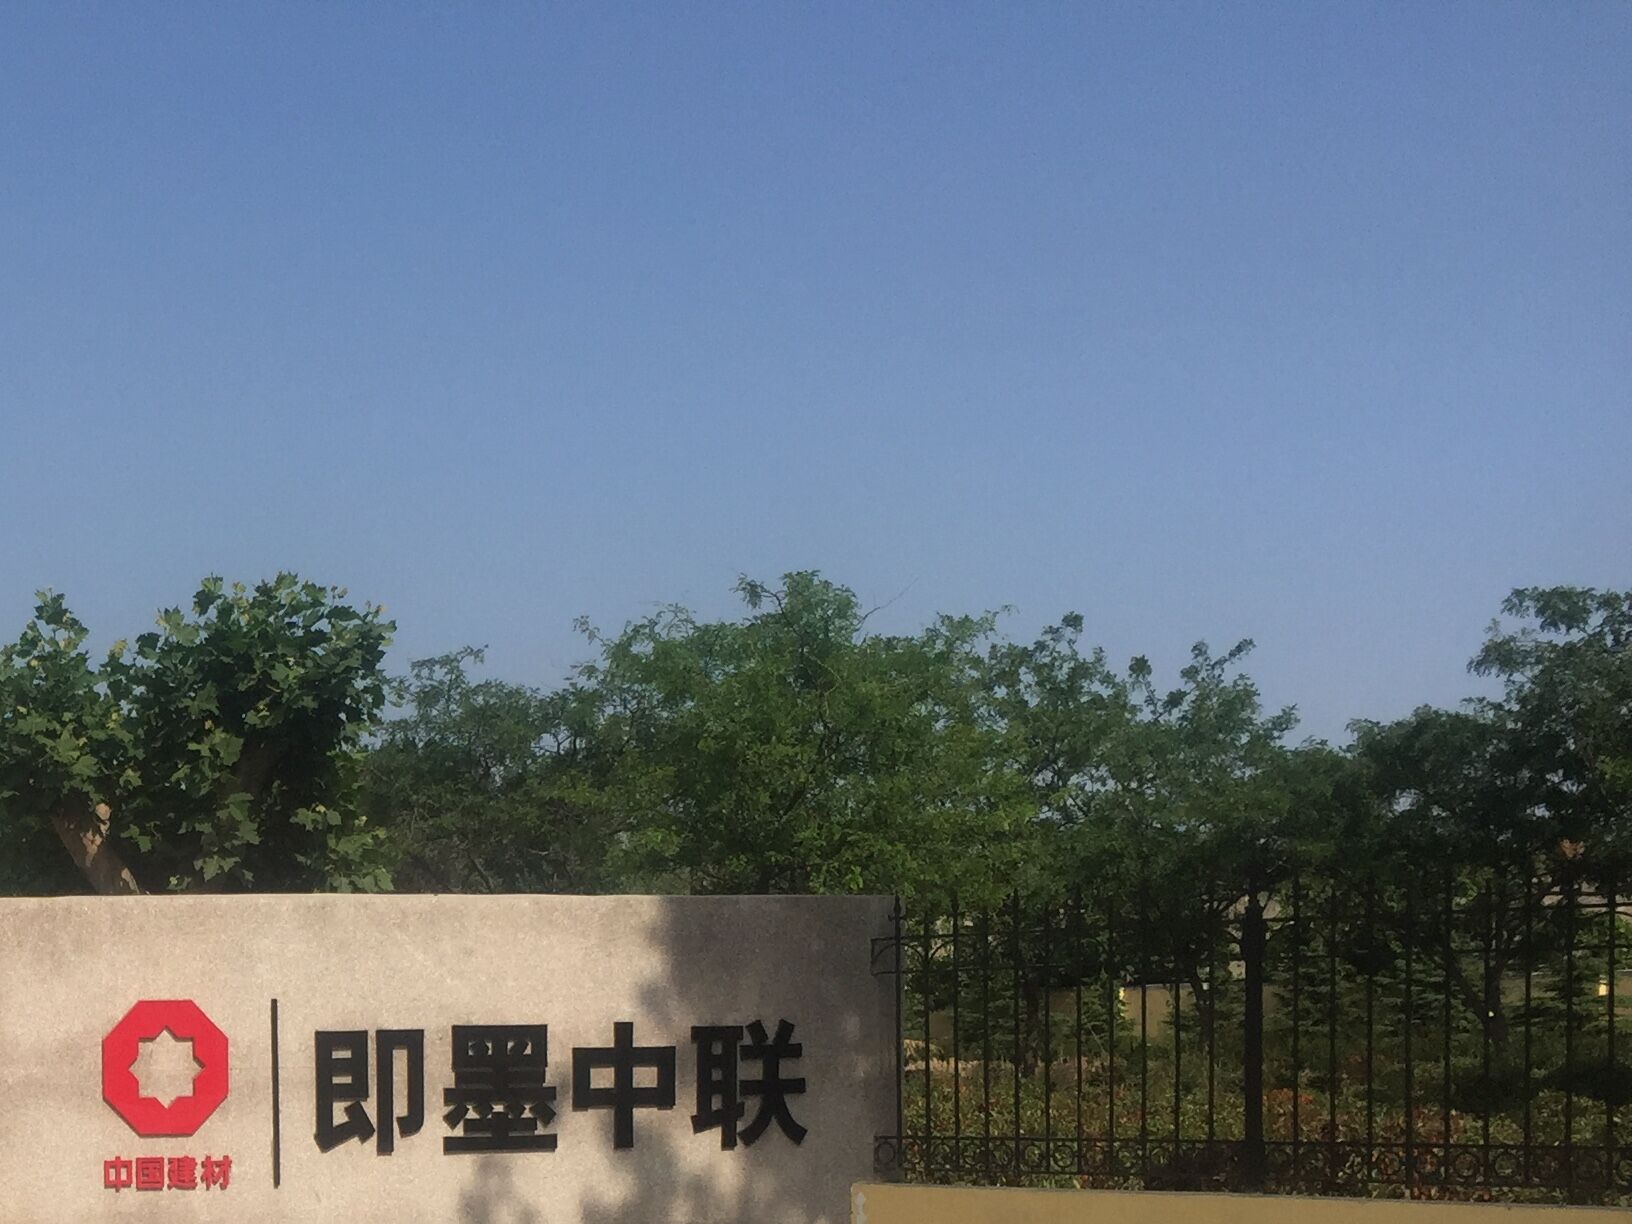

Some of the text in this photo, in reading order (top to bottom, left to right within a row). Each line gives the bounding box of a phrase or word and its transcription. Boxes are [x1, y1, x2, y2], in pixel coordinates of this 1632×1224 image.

[313, 1018, 809, 1157] 即墨中联
[103, 1154, 232, 1193] 中国建材
